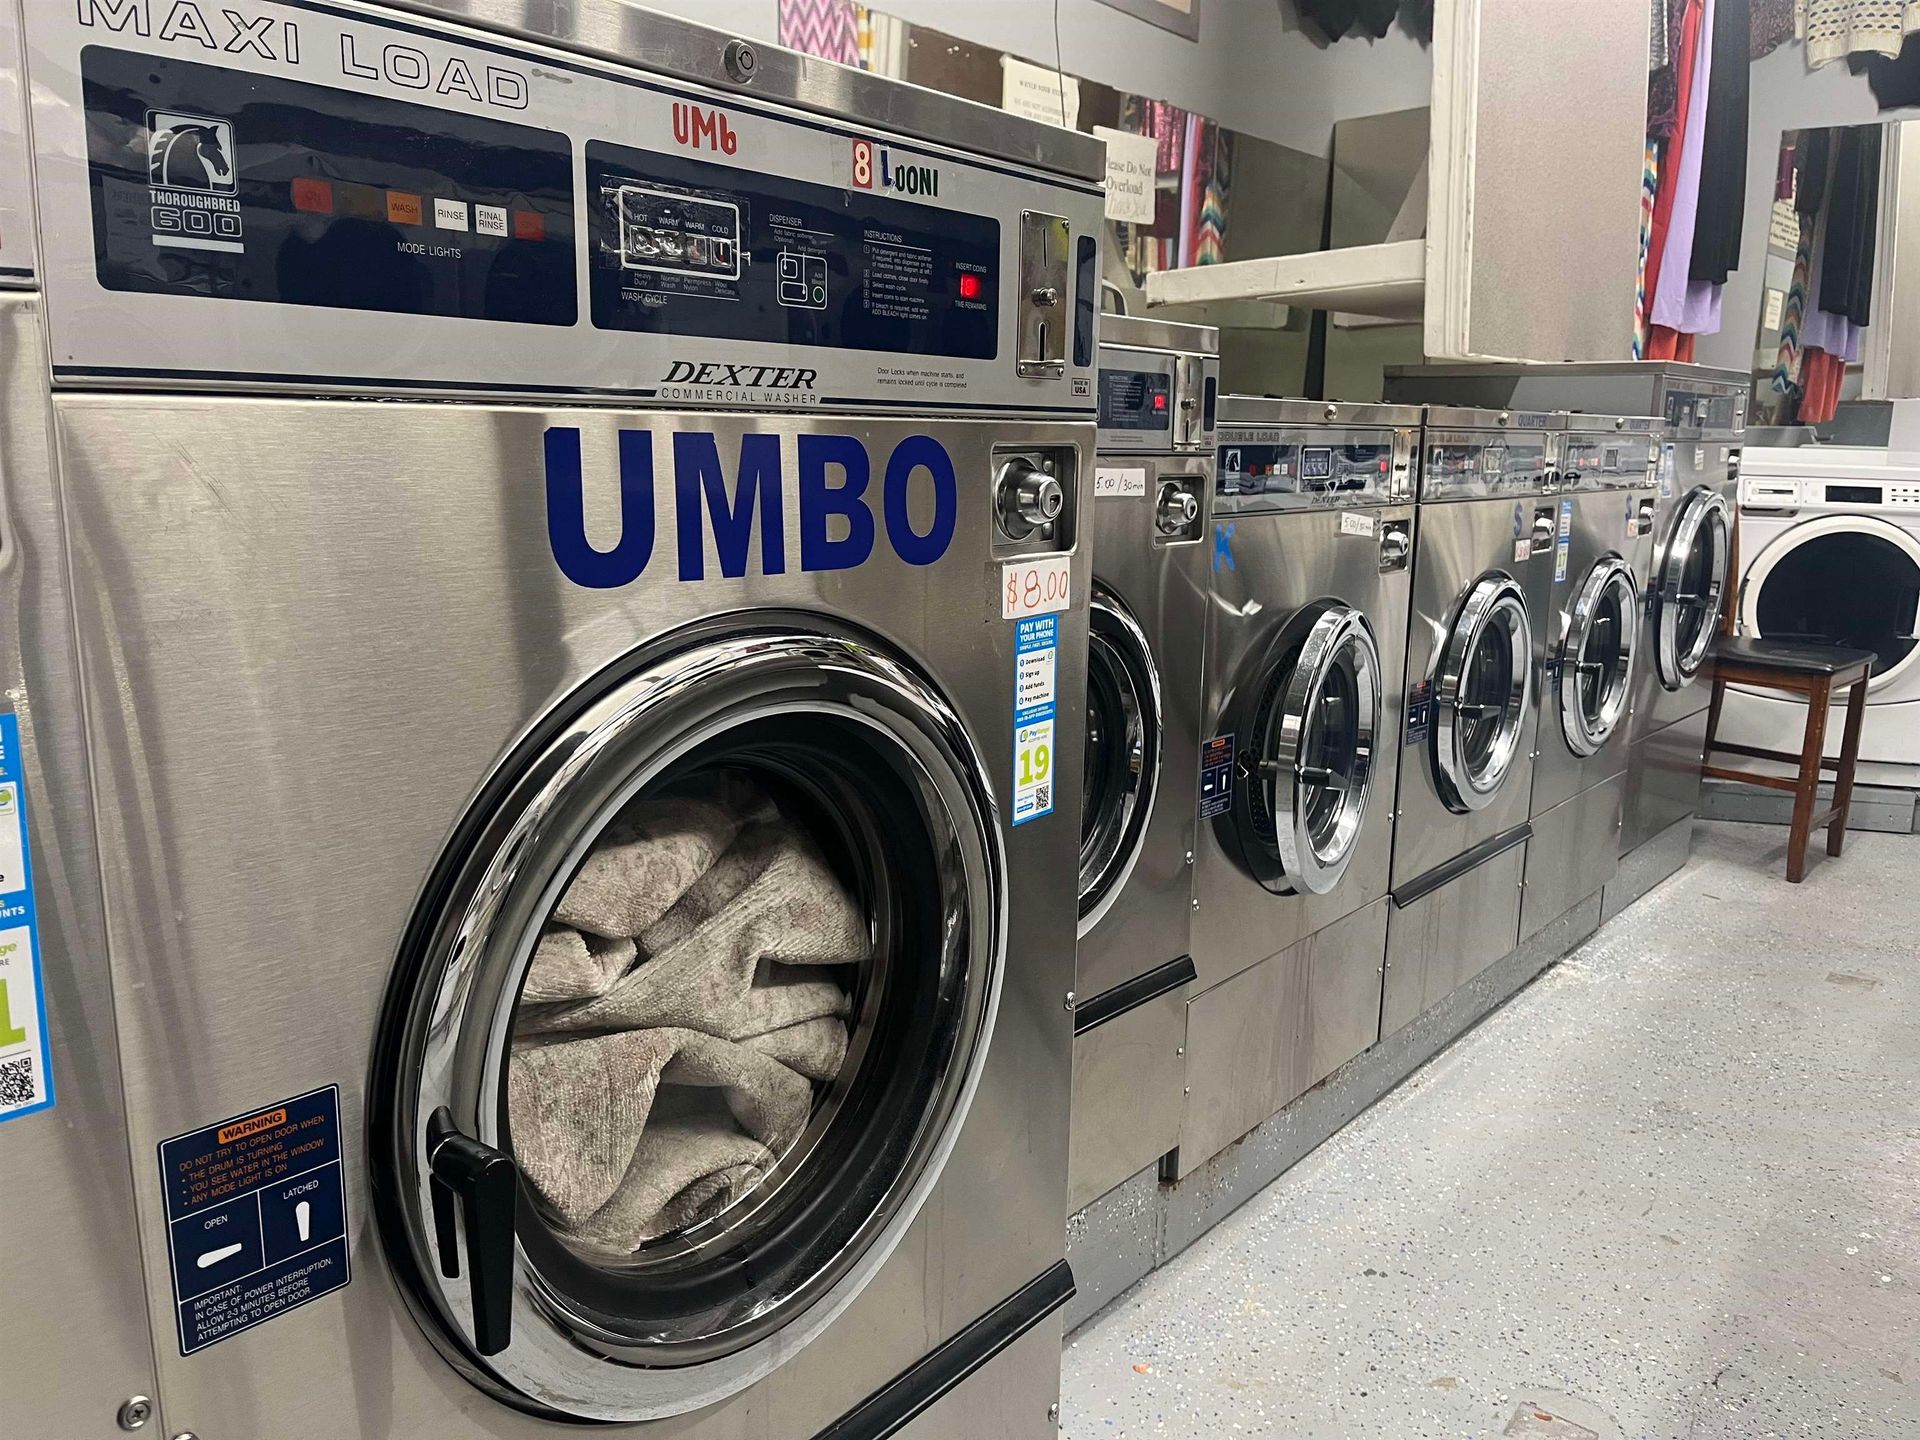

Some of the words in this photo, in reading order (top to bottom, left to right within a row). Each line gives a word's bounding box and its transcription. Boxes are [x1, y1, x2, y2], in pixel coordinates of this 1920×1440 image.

[77, 0, 300, 64] MAXI
[340, 33, 529, 111] LOAD
[854, 140, 871, 187] 8
[1127, 160, 1138, 174] Do
[1138, 163, 1152, 177] Not
[1106, 175, 1143, 195] Overload
[149, 190, 241, 213] THOROUGHBRED
[391, 202, 418, 214] WASH
[151, 206, 243, 238] 600
[437, 208, 465, 221] RINSE
[479, 210, 503, 222] FINAL
[769, 213, 803, 227] DISPENSER
[478, 219, 505, 231] RINSE
[634, 213, 648, 222] HOT
[658, 217, 680, 227] WARM
[685, 221, 705, 230] WARM
[711, 225, 729, 235] COLD
[863, 229, 903, 243] INSTRUCTIONS
[397, 242, 425, 255] MODE
[429, 246, 462, 259] LIGHTS
[955, 261, 972, 271] INSERT
[972, 264, 987, 273] COINS
[634, 271, 651, 281] Heavy
[660, 274, 680, 282] Normal
[683, 277, 712, 287] Permpress
[634, 278, 648, 287] Duty
[660, 280, 676, 289] Wash
[683, 283, 699, 292] Nylon
[621, 290, 643, 300] WASH
[645, 293, 668, 305] CYCLE
[661, 360, 817, 390] DEXTER
[877, 367, 889, 375] Door
[890, 368, 905, 376] Locks
[906, 369, 919, 377] when
[920, 370, 940, 378] machine
[662, 387, 756, 401] COMMERCIAL
[763, 392, 816, 404] WASHER
[1074, 386, 1086, 394] USA
[1517, 414, 1548, 427] QUARTER
[1217, 431, 1254, 442] DOUBLE
[1256, 431, 1280, 442] LOAD
[543, 426, 958, 589] UMBO
[1007, 570, 1068, 613] $8.00
[1020, 621, 1035, 634] PAY
[1035, 618, 1054, 631] WITH
[1020, 632, 1036, 643] YOUR
[1036, 628, 1054, 640] PHONE
[1025, 655, 1045, 665] Download
[1025, 671, 1034, 679] Sign
[1034, 670, 1040, 678] up
[1034, 680, 1045, 688] funds
[1032, 691, 1050, 700] machine
[1019, 744, 1050, 787] 19
[222, 1112, 283, 1140] WARNING
[179, 1160, 193, 1172] DO
[194, 1153, 212, 1167] NOT
[216, 1146, 232, 1159] TRY
[235, 1141, 247, 1152] TO
[249, 1133, 272, 1147] OPEN
[274, 1123, 298, 1139] DOOR
[300, 1114, 325, 1129] WHEN
[189, 1168, 206, 1181] THE
[208, 1159, 234, 1175] DRUM
[236, 1155, 245, 1165] IS
[247, 1141, 283, 1160] TURNING
[190, 1180, 209, 1193] YOU
[211, 1172, 228, 1186] SEE
[229, 1161, 259, 1178] WATER
[261, 1157, 270, 1167] IN
[272, 1150, 289, 1163] THE
[290, 1138, 325, 1157] WINDOW
[191, 1191, 208, 1205] ANY
[211, 1181, 236, 1197] MODE
[238, 1171, 262, 1187] LIGHT
[264, 1167, 273, 1178] IS
[274, 1162, 288, 1174] ON
[282, 1179, 319, 1200] LATCHED
[204, 1213, 228, 1230] OPEN
[194, 1284, 243, 1311] IMPORTANT:
[195, 1311, 204, 1321] IN
[206, 1301, 229, 1317] CASE
[230, 1296, 242, 1307] OF
[244, 1281, 274, 1301] POWER
[196, 1312, 225, 1332] ALLOW
[227, 1308, 239, 1319] 2-3
[240, 1292, 276, 1313] MINUTES
[277, 1277, 310, 1297] BEFORE
[198, 1313, 249, 1342] ATTEMPTING
[250, 1307, 262, 1319] TO
[263, 1298, 286, 1314] OPEN
